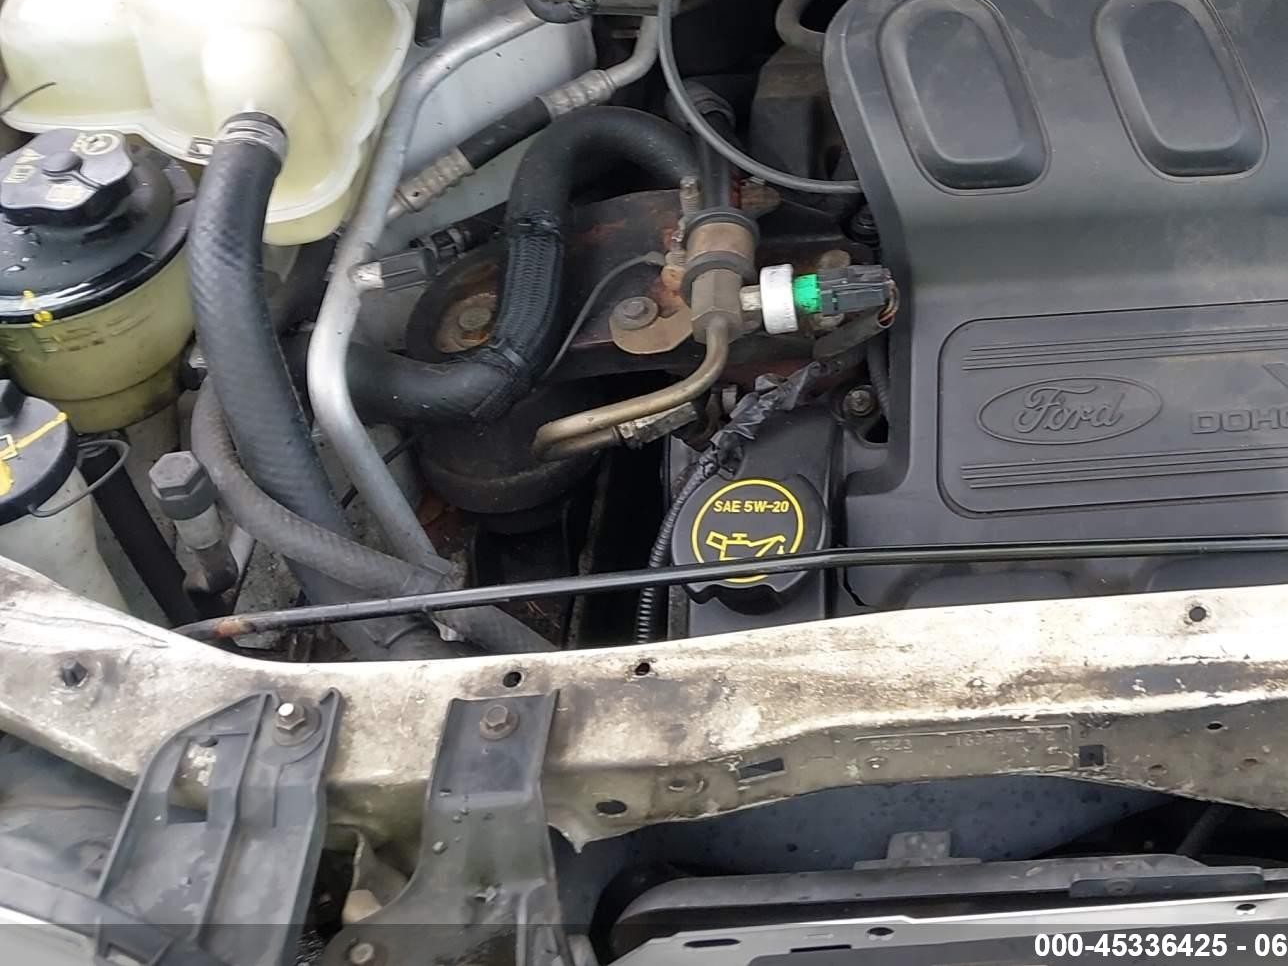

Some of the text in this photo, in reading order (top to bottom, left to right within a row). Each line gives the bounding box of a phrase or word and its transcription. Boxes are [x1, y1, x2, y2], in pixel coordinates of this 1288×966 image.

[1014, 383, 1124, 434] Ford
[713, 500, 790, 513] SAE 5W-20
